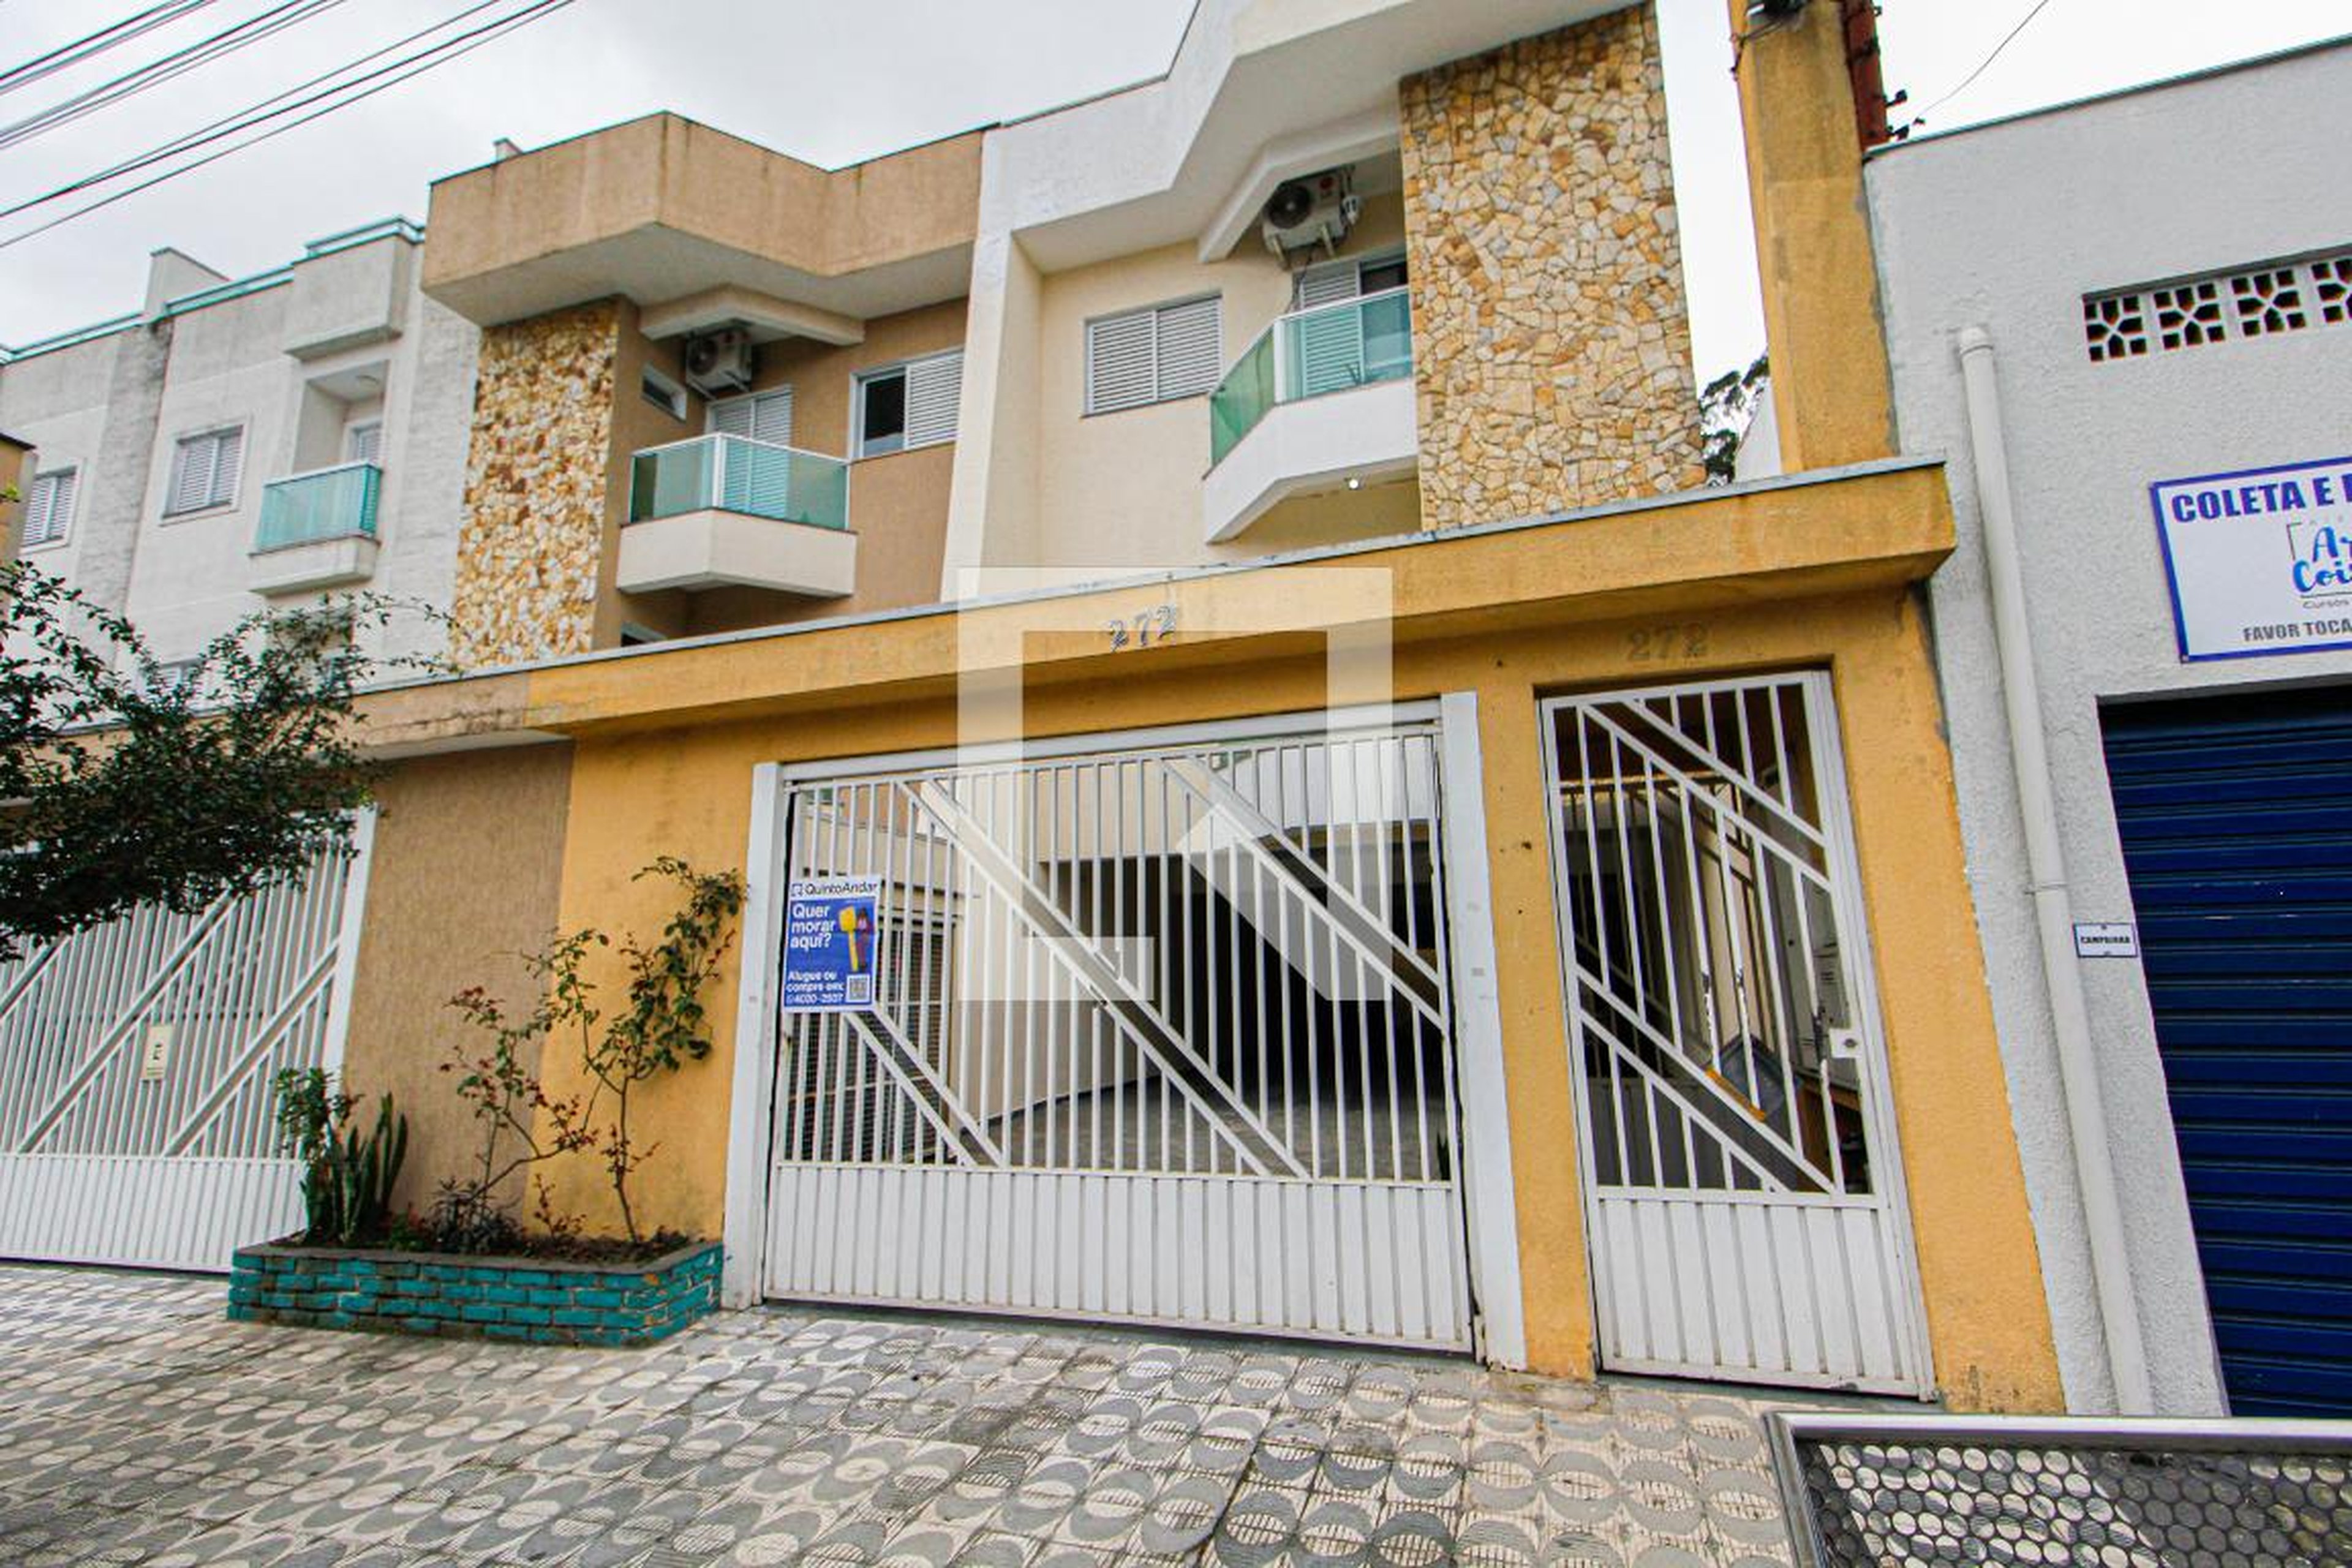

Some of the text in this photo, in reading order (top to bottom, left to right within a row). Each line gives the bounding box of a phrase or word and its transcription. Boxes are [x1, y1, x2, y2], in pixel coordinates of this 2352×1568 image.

[2171, 481, 2307, 522] COLETA
[2312, 477, 2334, 507] E
[2293, 560, 2352, 593] Coi
[1109, 604, 1177, 653] 272
[2242, 622, 2300, 642] FAVOR
[1626, 621, 1709, 662] 272
[805, 881, 878, 895] QuintoAndar
[791, 904, 831, 919] Quer
[791, 919, 836, 933] morar
[790, 933, 832, 952] aqui?
